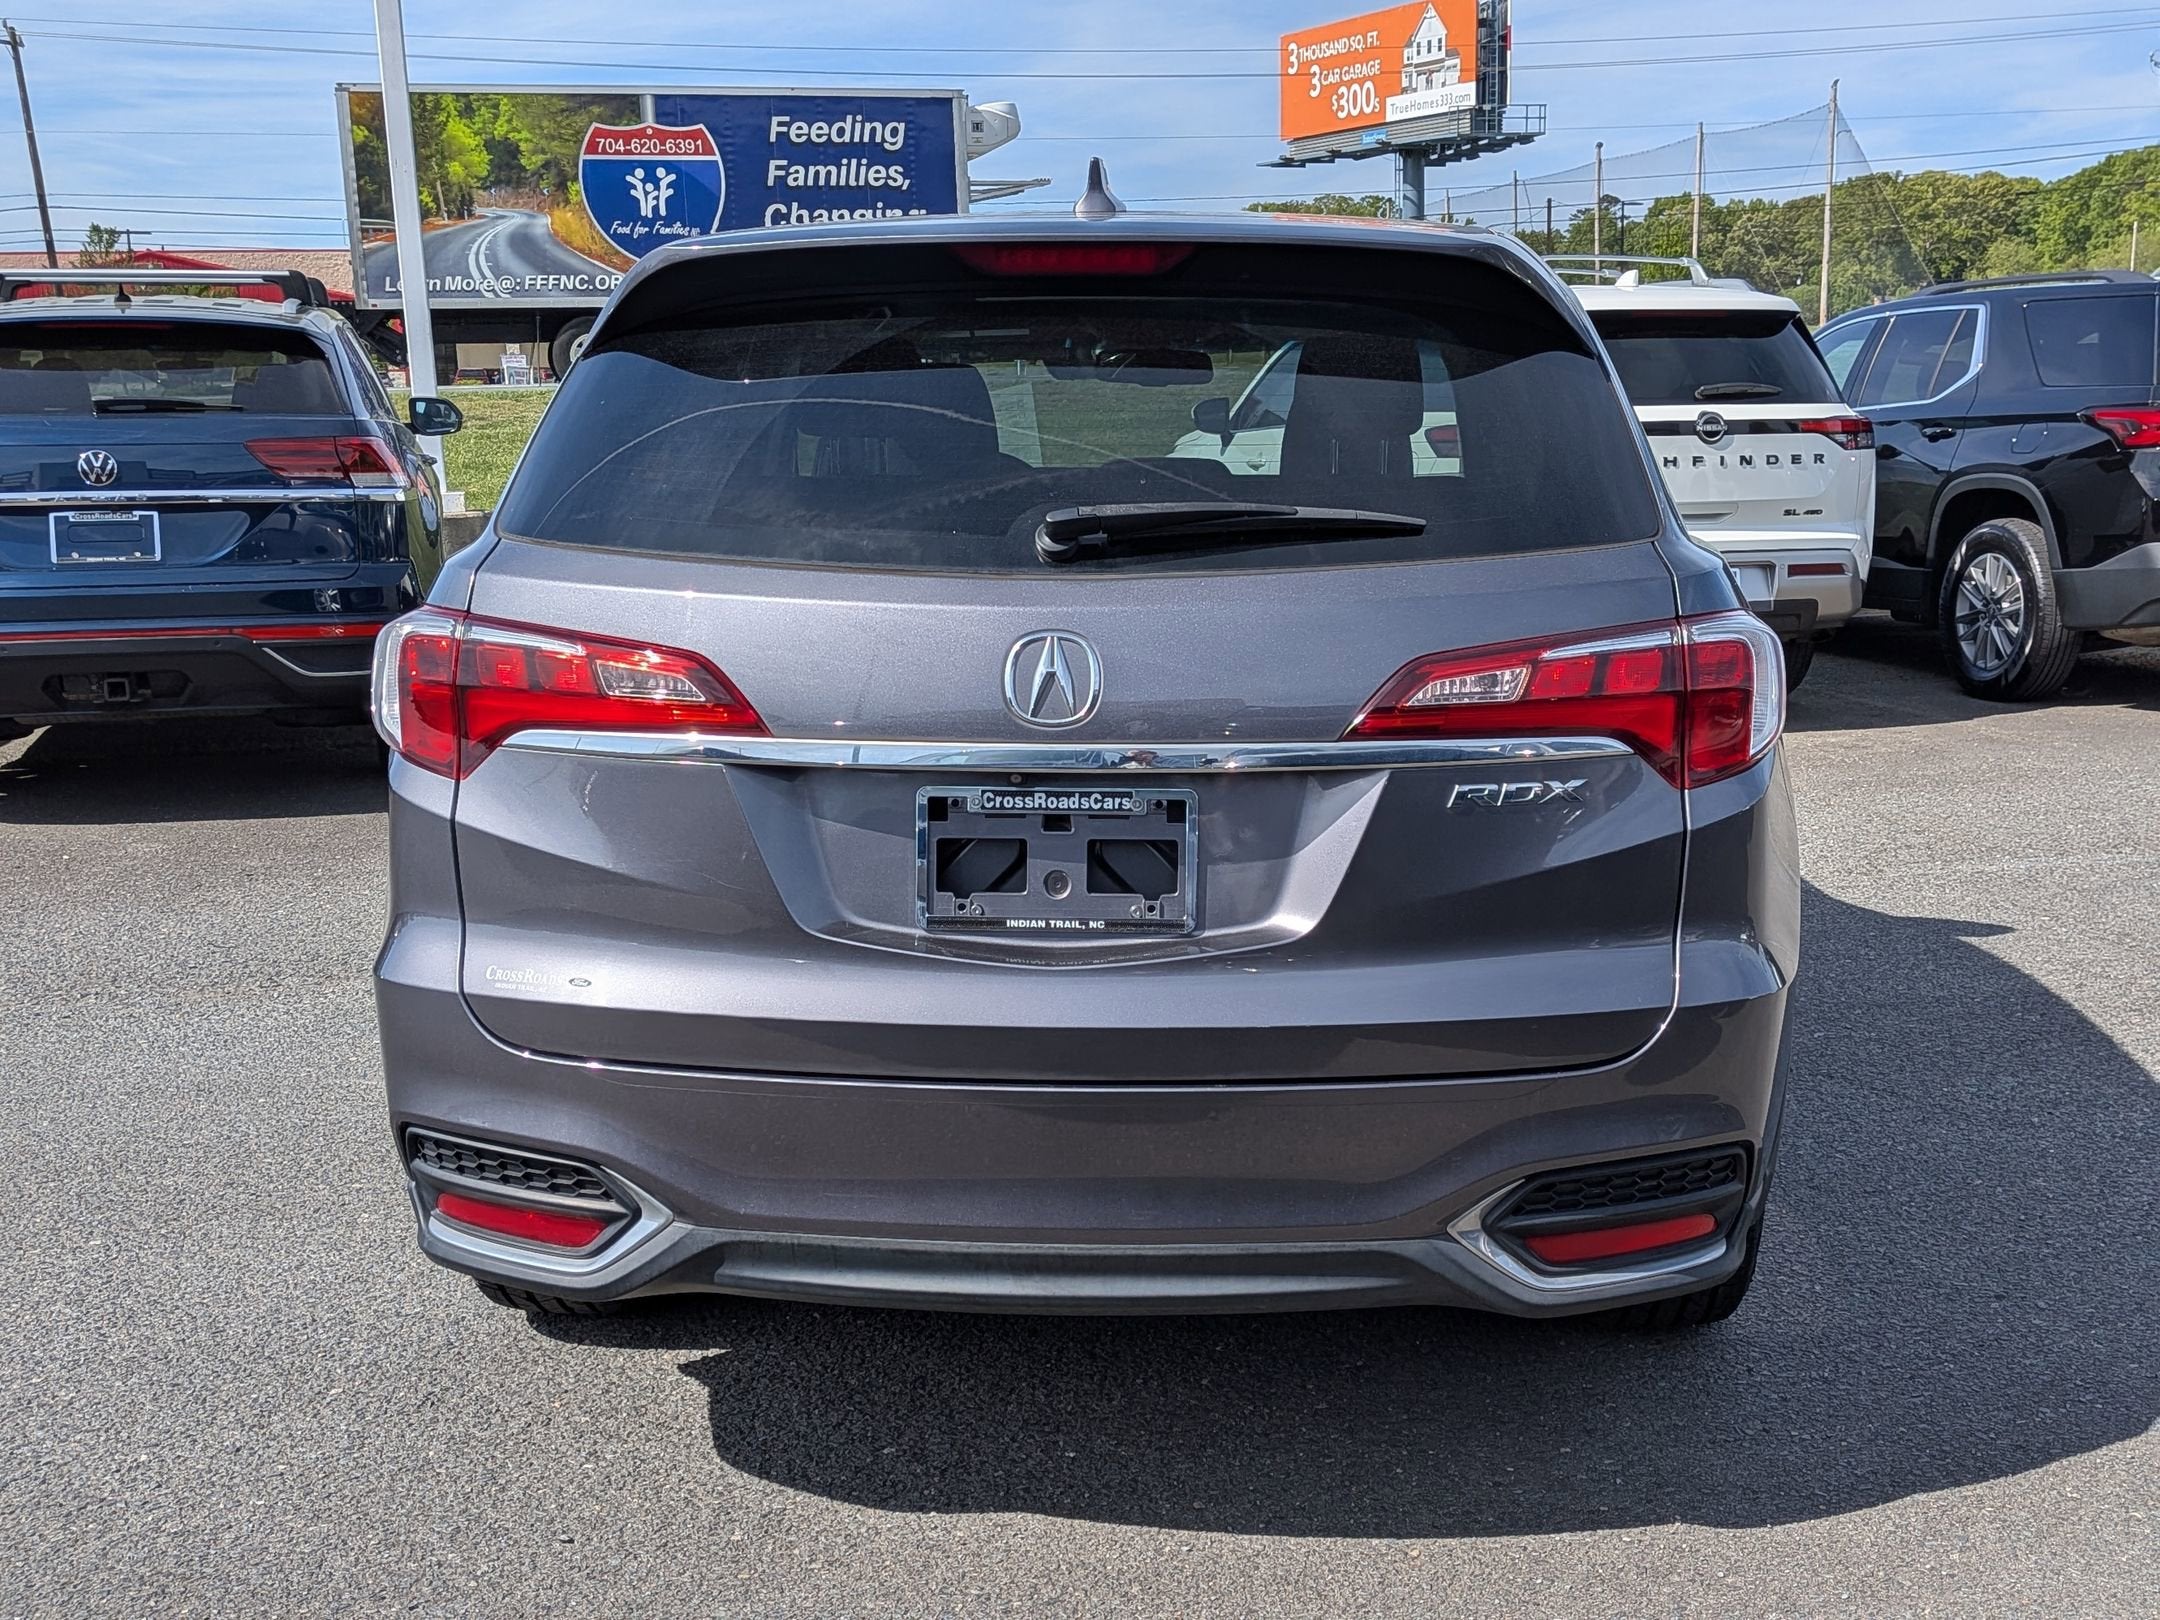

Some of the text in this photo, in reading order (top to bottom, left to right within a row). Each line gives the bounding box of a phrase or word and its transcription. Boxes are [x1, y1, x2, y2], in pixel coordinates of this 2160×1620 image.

[1287, 30, 1380, 75] 3 THOUSAND SQ. FT.
[1309, 59, 1381, 98] 3 CAR GARAGE
[1389, 92, 1472, 116] TrueHomes333.com
[769, 114, 906, 151] Feeding
[595, 138, 703, 154] 704-620-6391
[767, 158, 911, 190] Families,
[610, 221, 633, 235] Food
[633, 221, 650, 239] for
[653, 221, 690, 236] Families
[445, 276, 494, 291] More
[1663, 453, 1826, 469] HFINDER
[982, 791, 1131, 810] CrossRoadsCars
[1447, 779, 1588, 808] RDX
[1006, 918, 1105, 931] INDIAN TRAIL, NC
